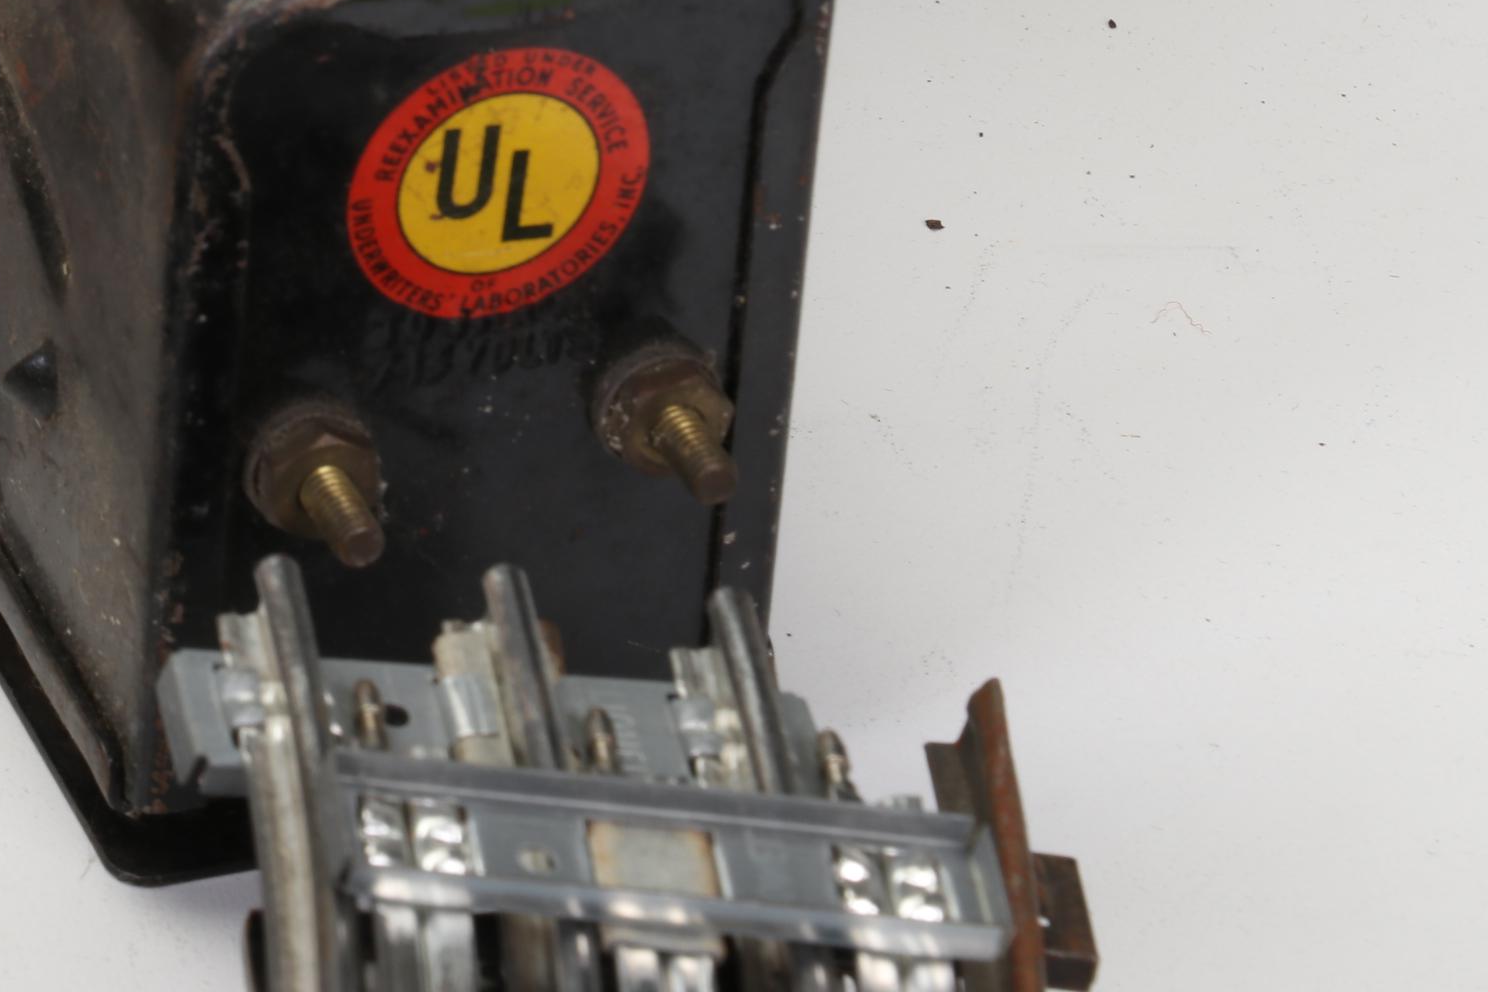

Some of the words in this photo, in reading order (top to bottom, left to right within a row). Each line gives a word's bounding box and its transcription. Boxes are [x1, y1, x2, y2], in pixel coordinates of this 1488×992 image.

[524, 50, 598, 77] UNDER
[564, 76, 630, 156] SERVICE
[436, 124, 554, 243] UL
